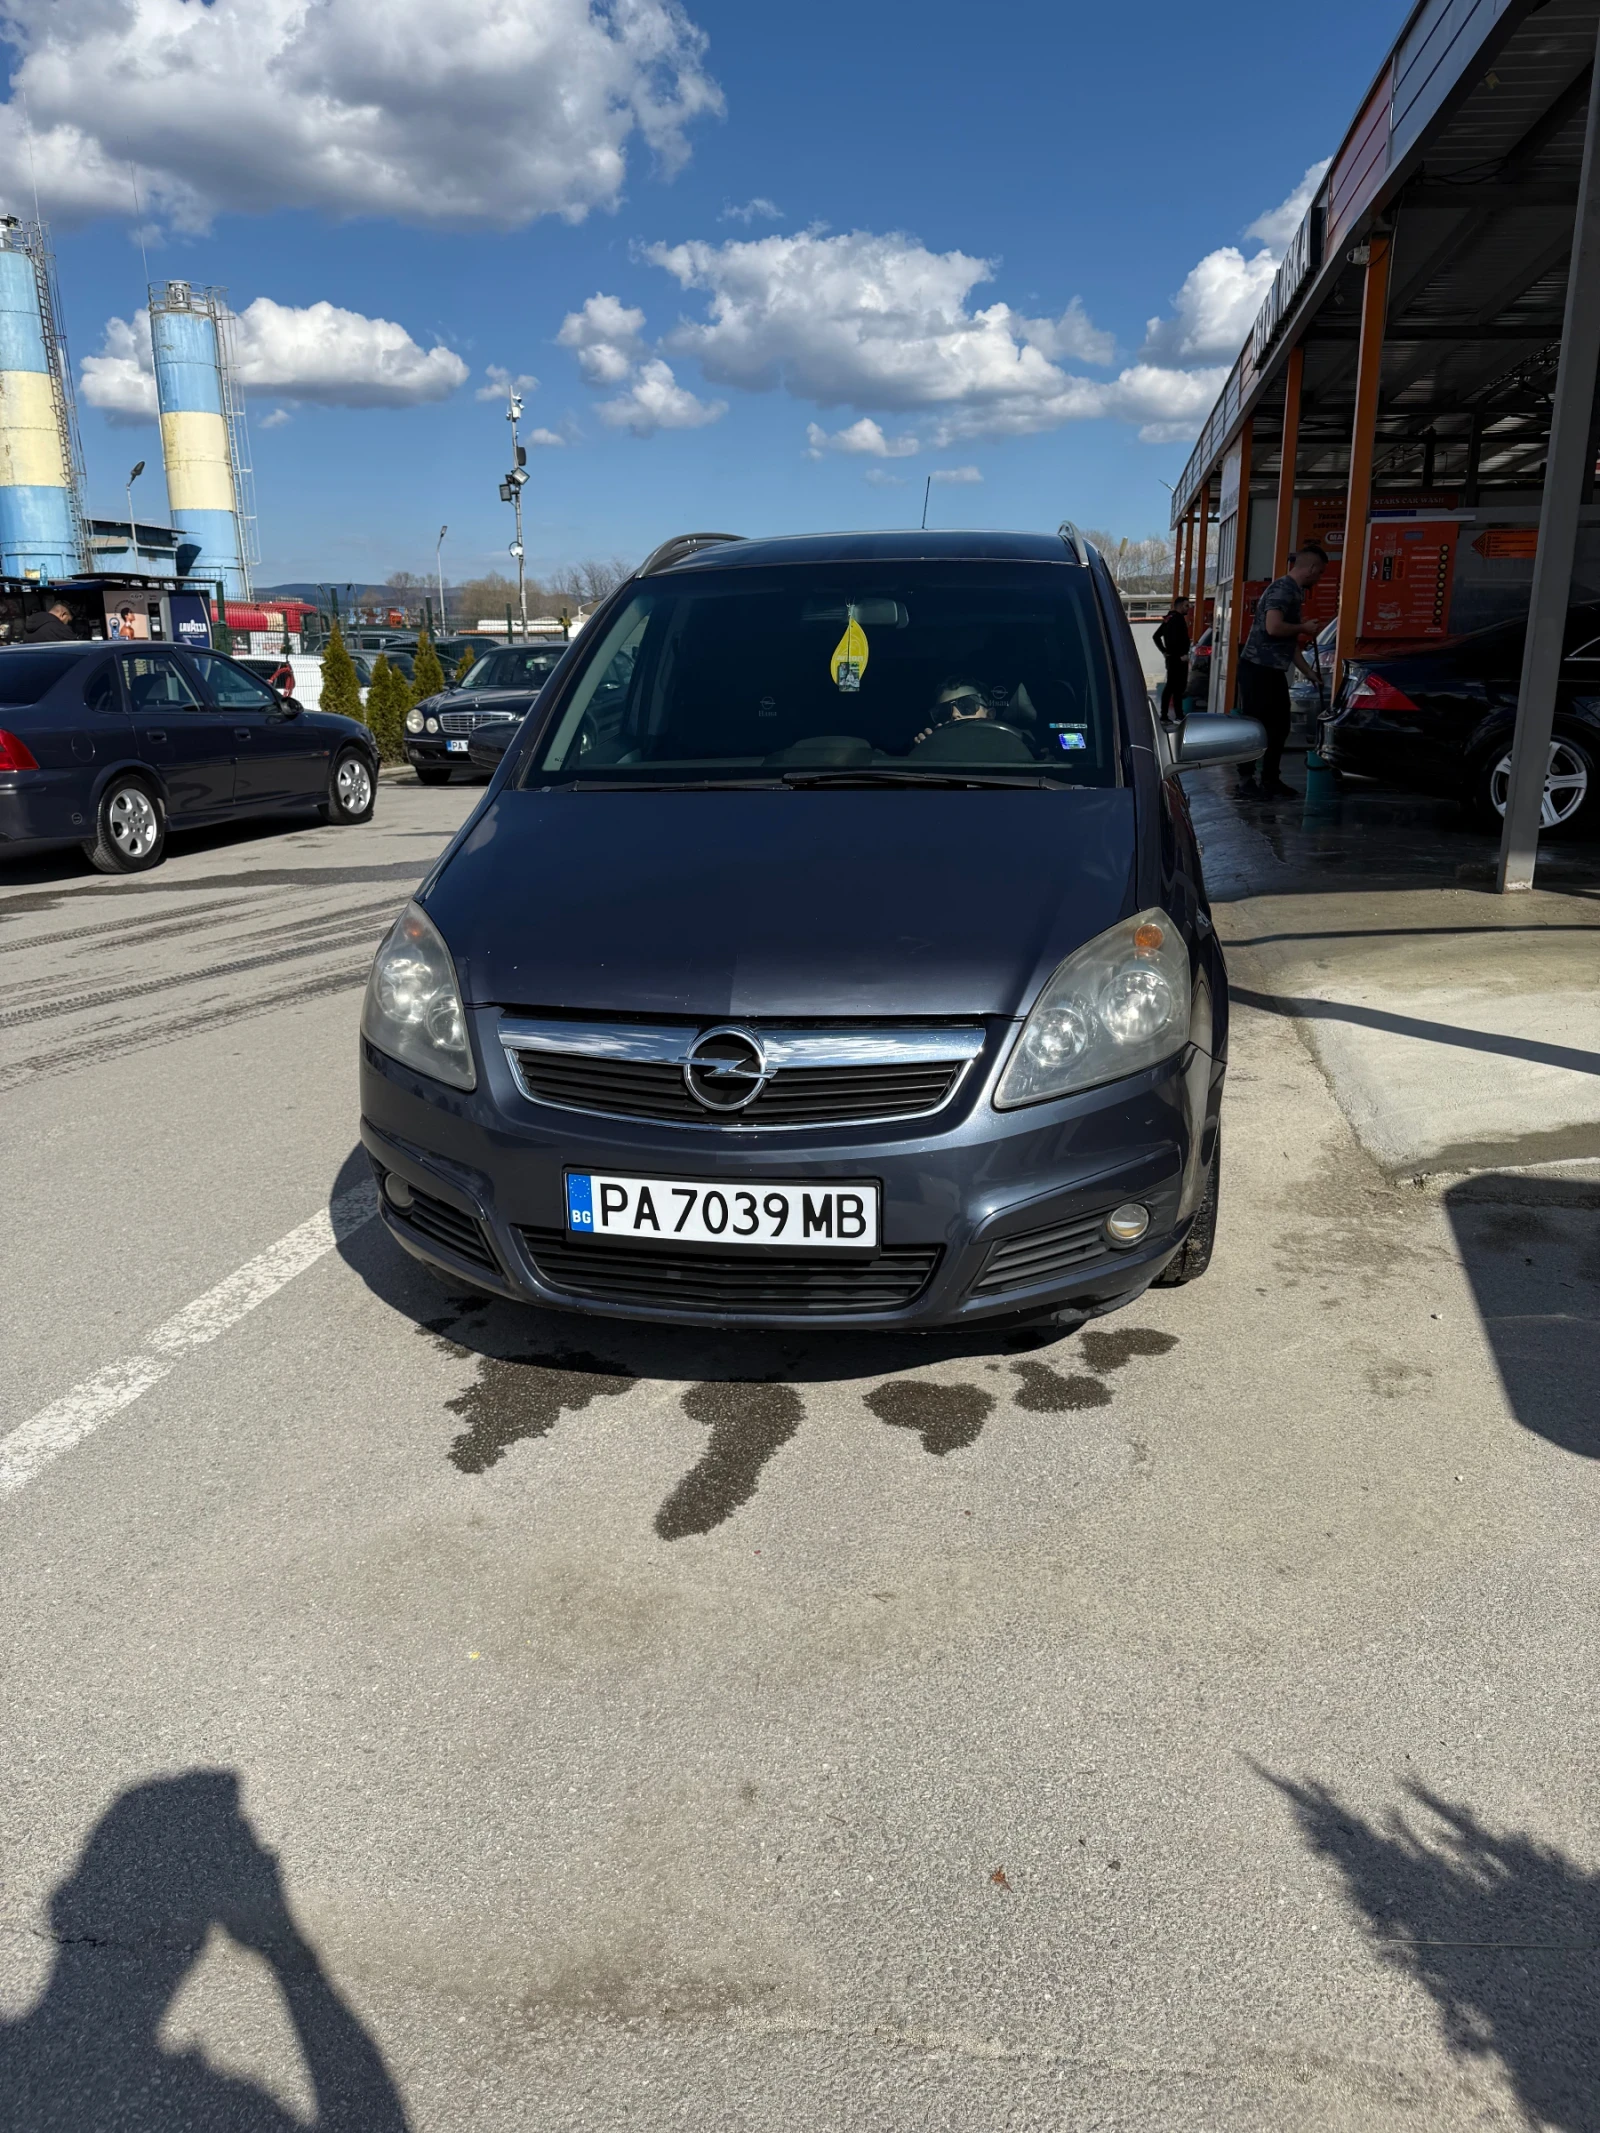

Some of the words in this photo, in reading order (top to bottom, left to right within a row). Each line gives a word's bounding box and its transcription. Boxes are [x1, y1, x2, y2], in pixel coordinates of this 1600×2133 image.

[179, 619, 207, 632] LAVAZZA
[452, 741, 463, 750] PA
[572, 1209, 591, 1224] BG
[600, 1183, 661, 1231] PA
[671, 1188, 790, 1237] 7039
[802, 1193, 867, 1239] MB
